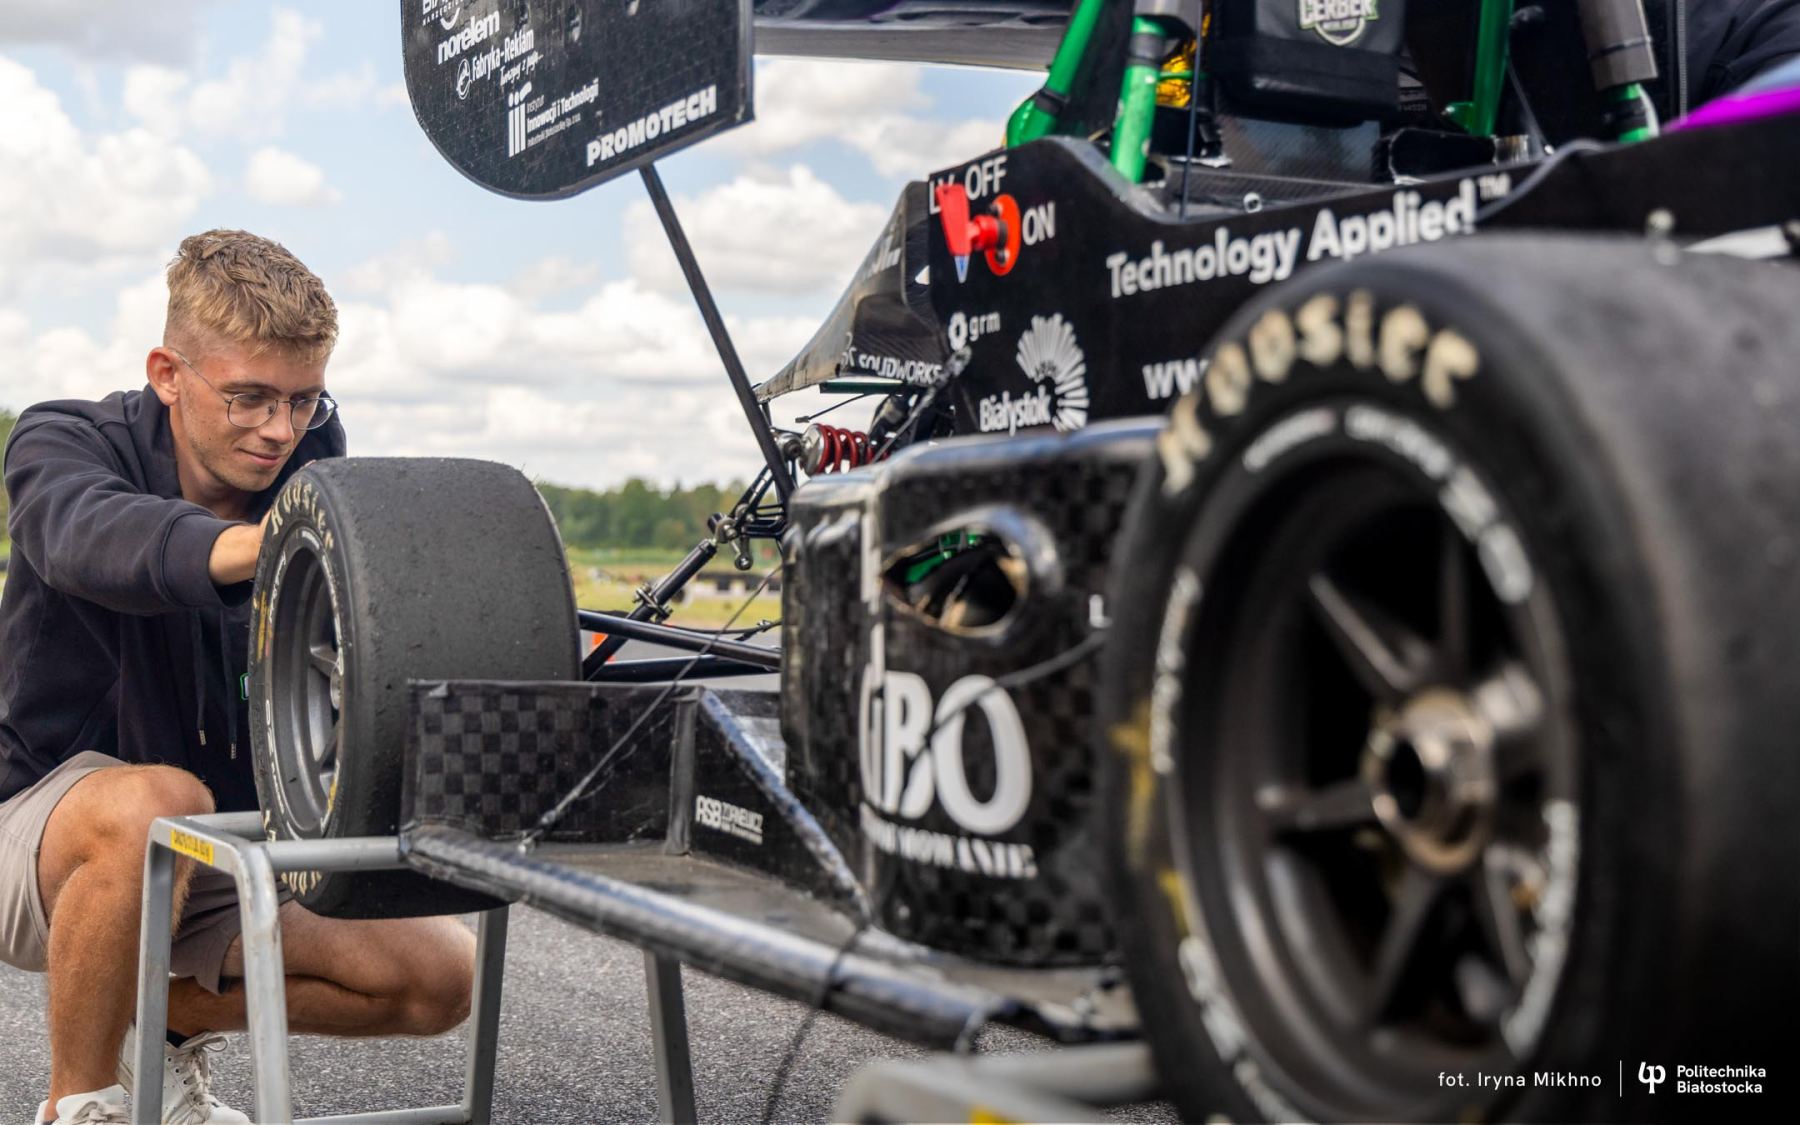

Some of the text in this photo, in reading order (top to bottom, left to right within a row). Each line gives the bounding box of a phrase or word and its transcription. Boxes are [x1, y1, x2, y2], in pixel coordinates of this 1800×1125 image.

[438, 10, 500, 65] norelem
[587, 85, 718, 167] PROMOTECH
[965, 156, 1007, 201] OFF
[1022, 201, 1055, 246] ON
[1106, 226, 1301, 298] Technology
[969, 312, 1000, 342] grm
